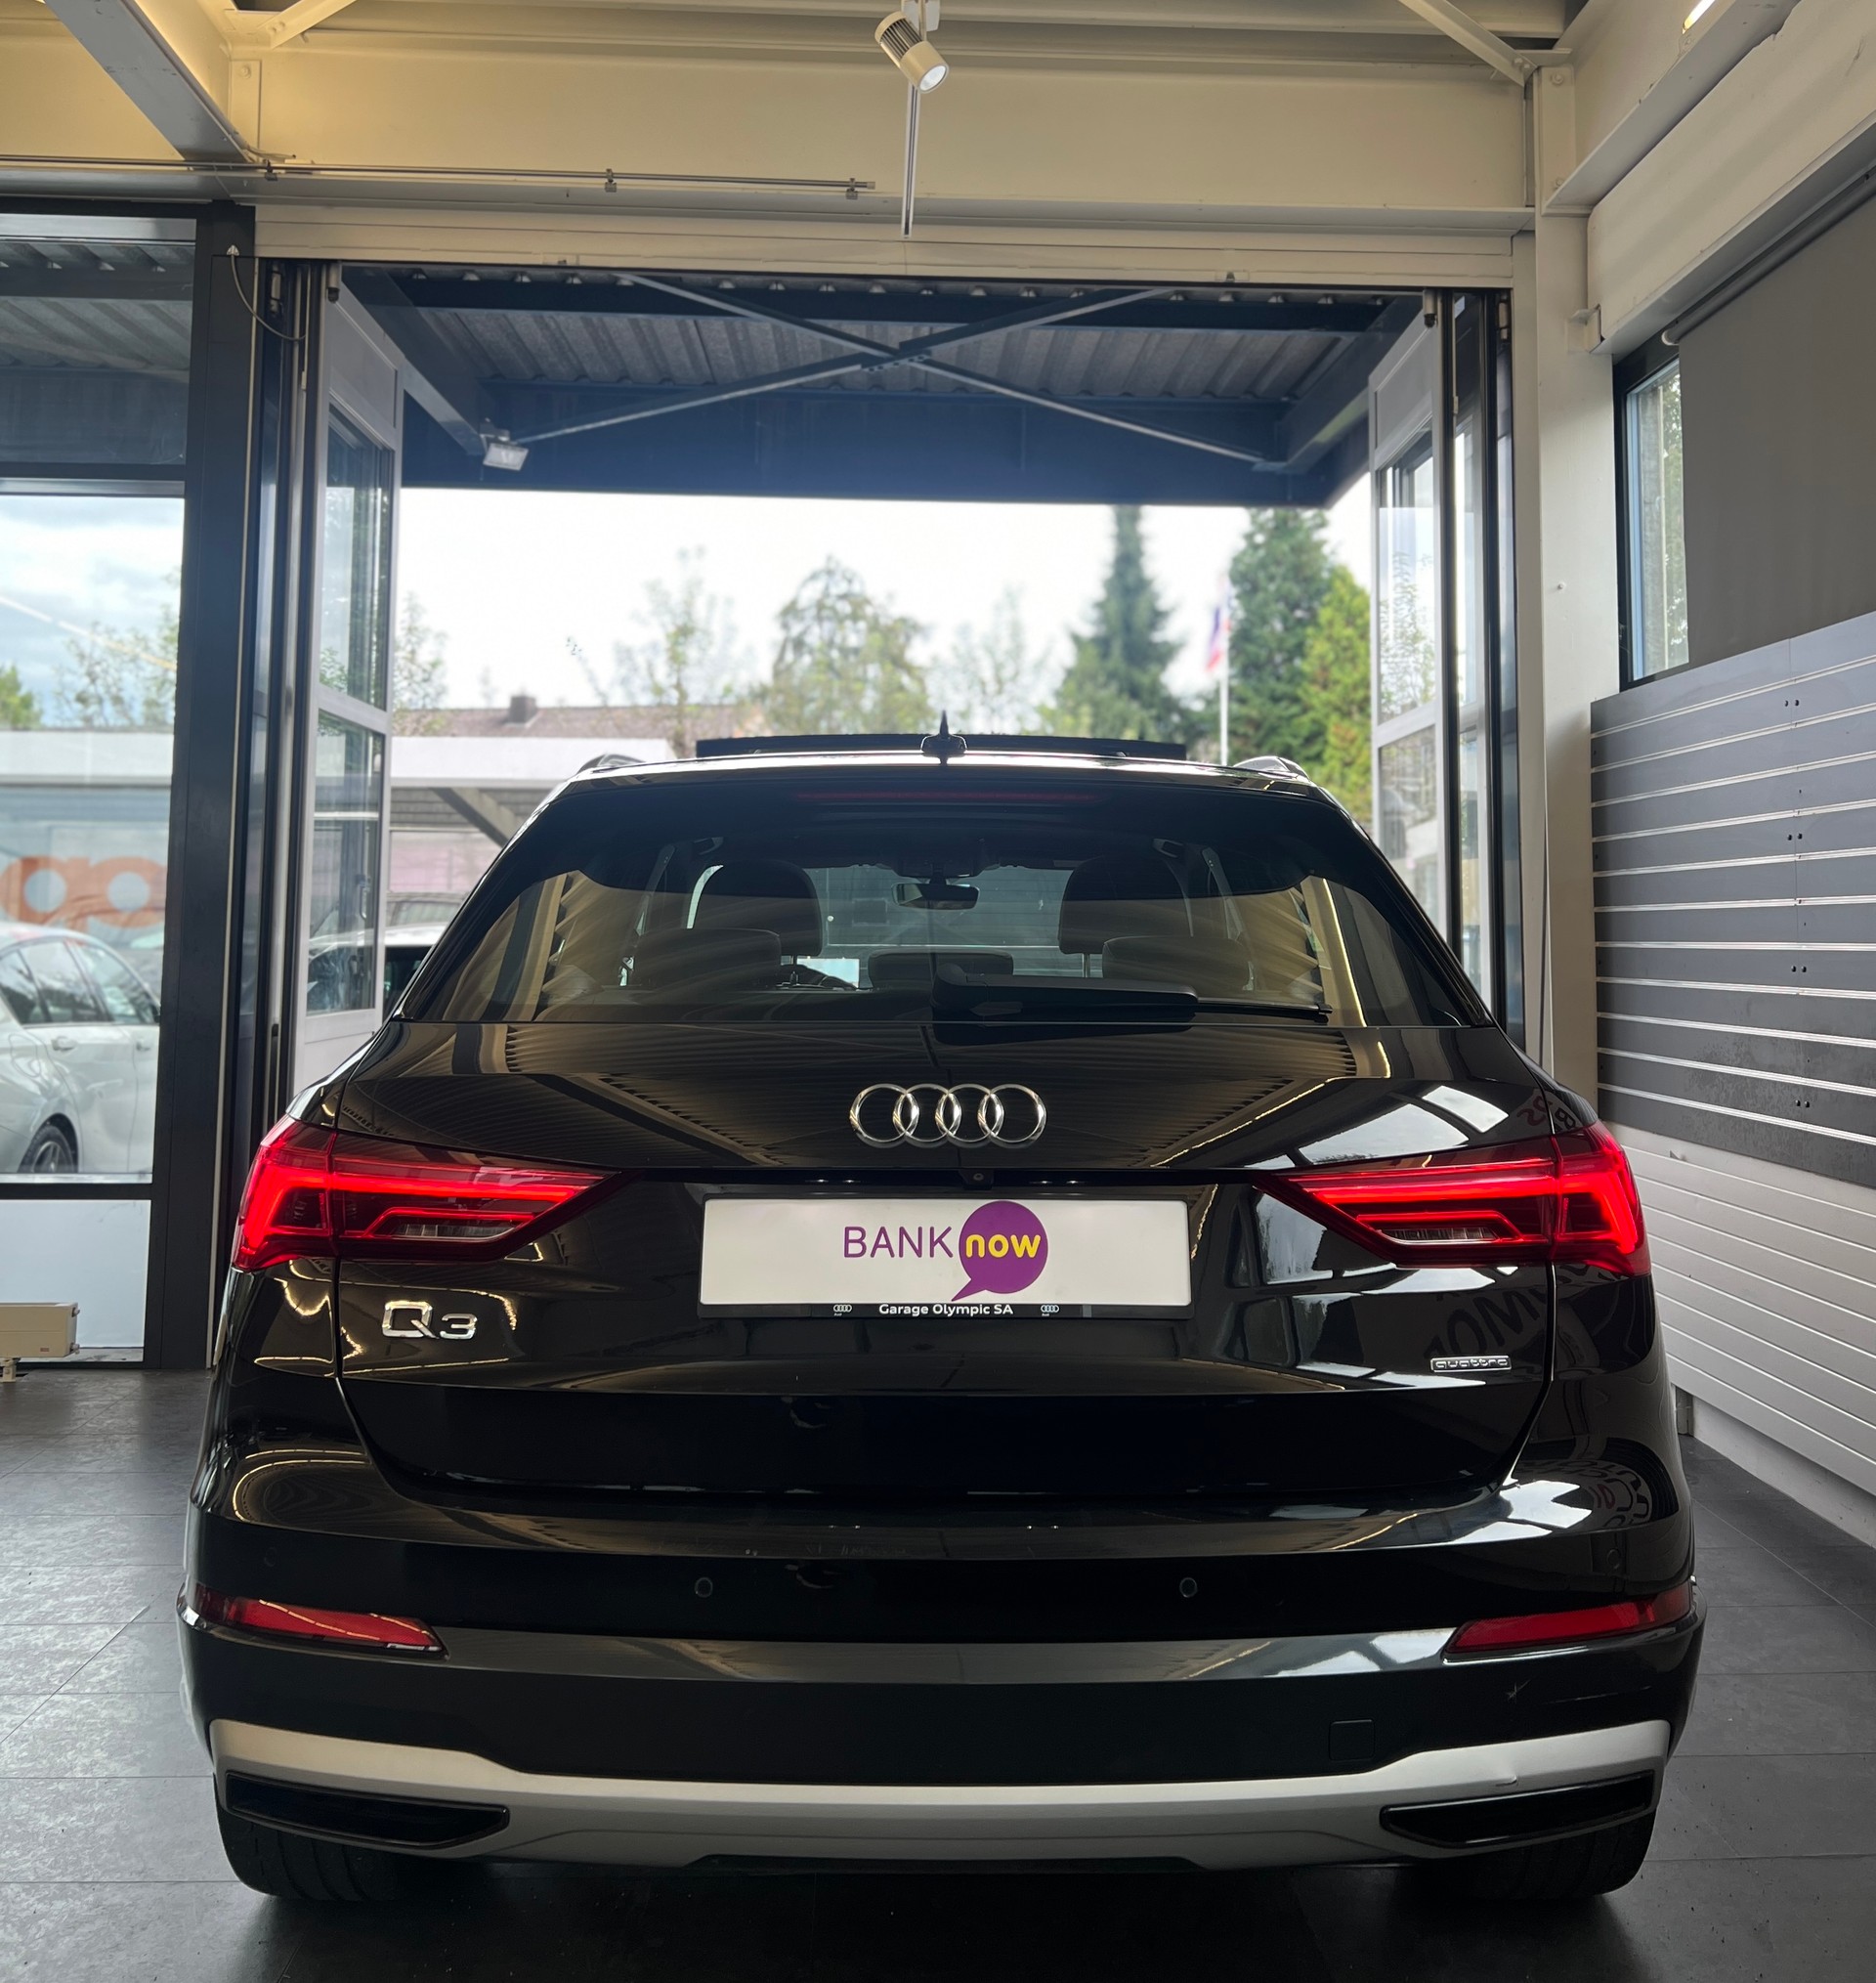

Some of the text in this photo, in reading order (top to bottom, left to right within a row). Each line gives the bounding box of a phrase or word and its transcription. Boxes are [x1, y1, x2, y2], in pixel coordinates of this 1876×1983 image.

[843, 1227, 1041, 1258] BANK now
[381, 1300, 477, 1339] Q3
[878, 1304, 1013, 1317] Garage Olympic SA
[1435, 1358, 1508, 1368] quattro
